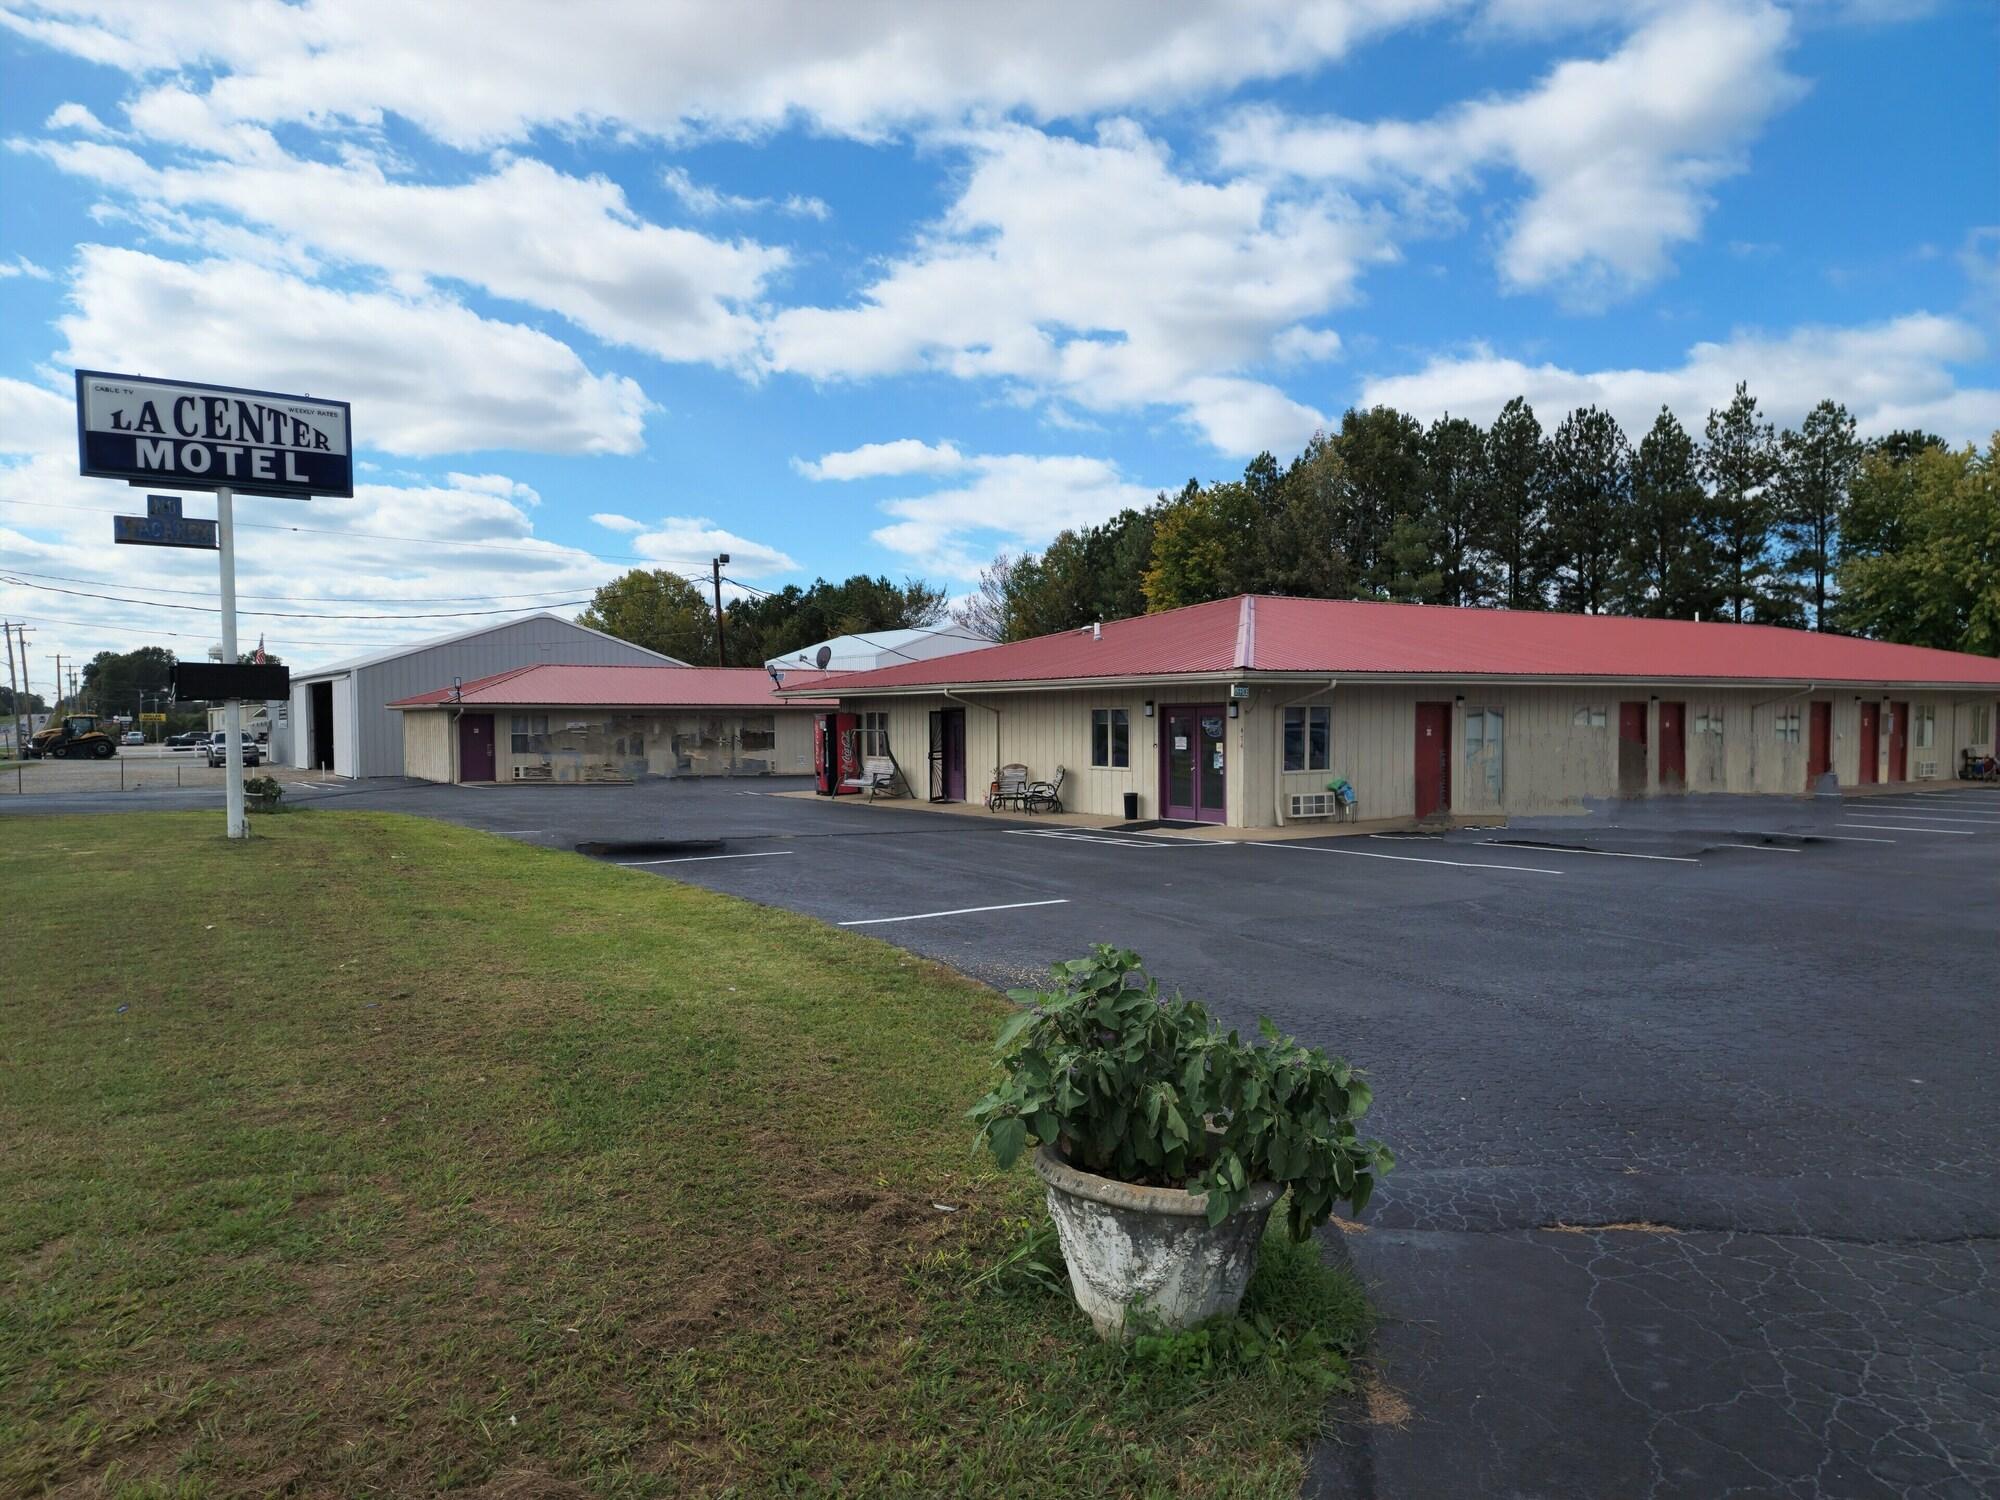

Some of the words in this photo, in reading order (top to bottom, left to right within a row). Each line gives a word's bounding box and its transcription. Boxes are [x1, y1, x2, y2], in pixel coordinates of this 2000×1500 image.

[94, 385, 120, 394] CABLE
[173, 395, 331, 452] CENTER
[288, 406, 315, 416] WEEKLY
[317, 409, 338, 418] RATES
[135, 438, 310, 483] MOTEL
